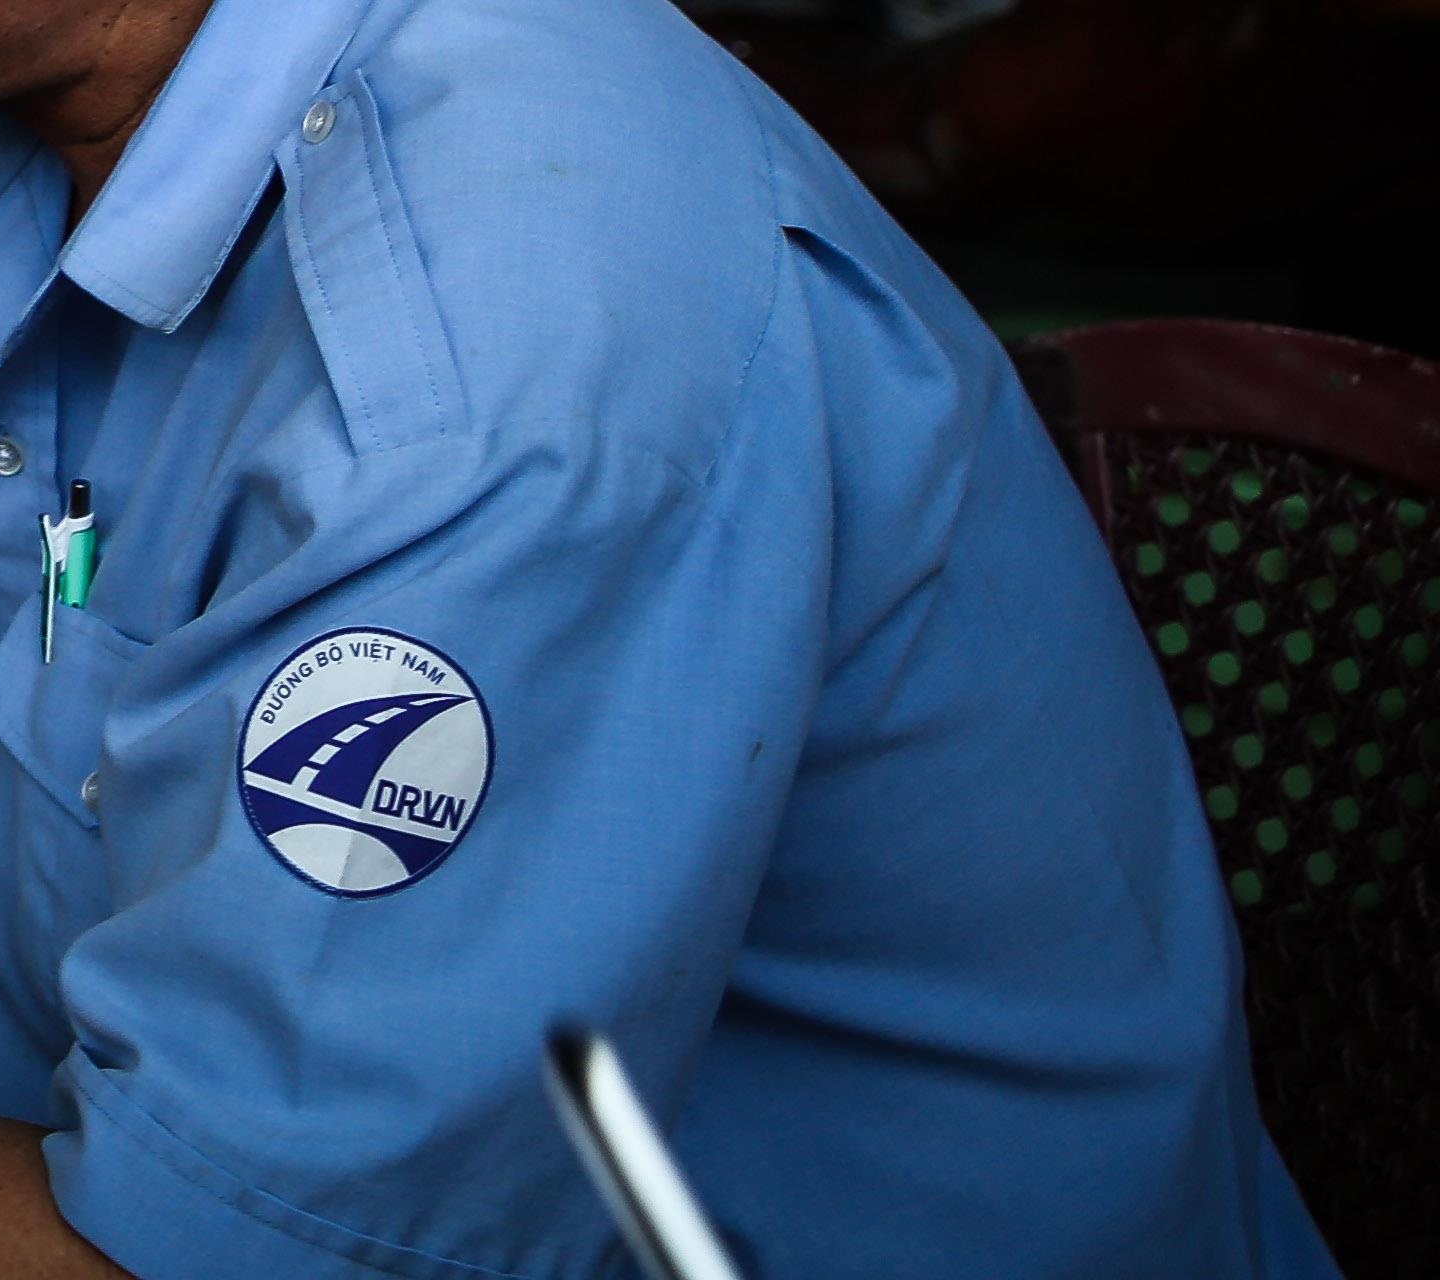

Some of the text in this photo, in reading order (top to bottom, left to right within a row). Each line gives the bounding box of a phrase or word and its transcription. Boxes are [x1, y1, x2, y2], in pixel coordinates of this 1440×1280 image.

[260, 639, 447, 724] ĐƯỜNG BỘ VIỆT NAM
[373, 779, 466, 831] DRVN
